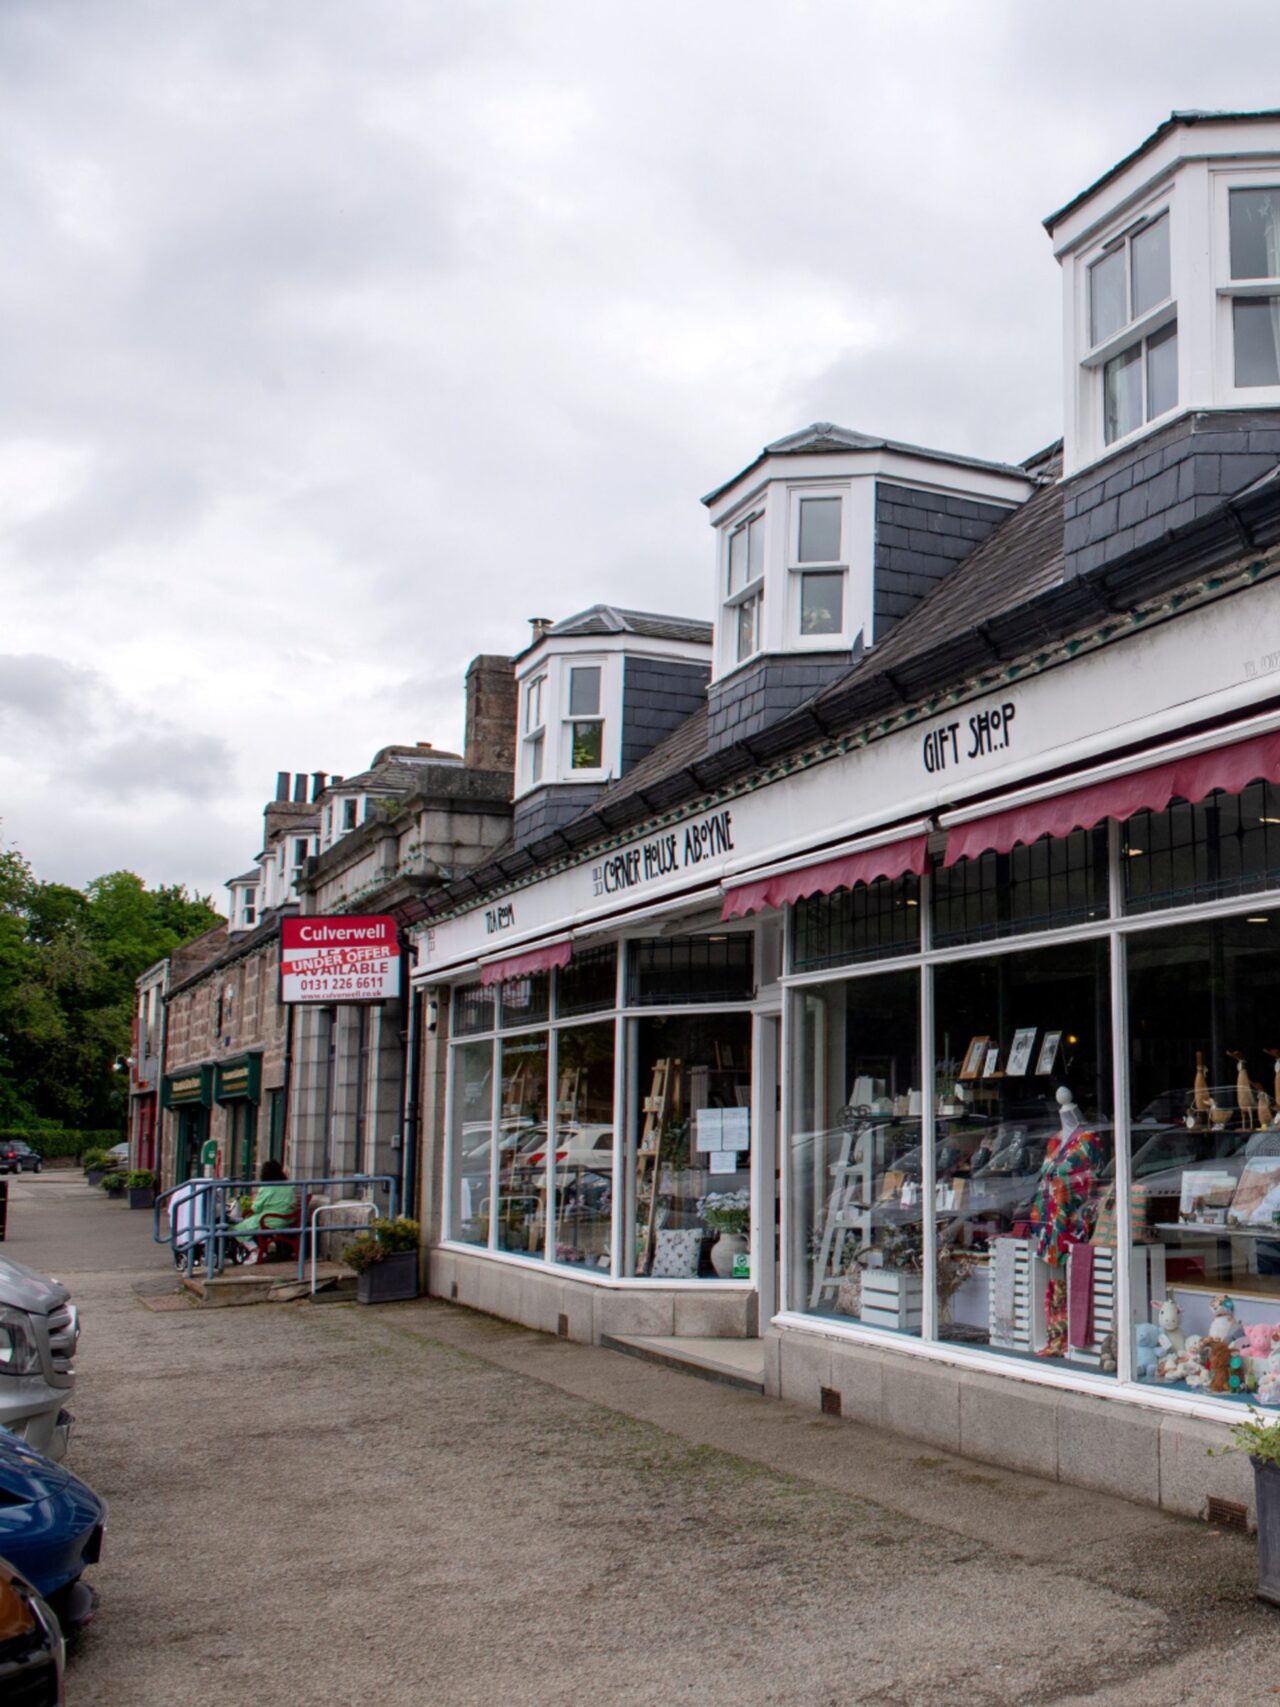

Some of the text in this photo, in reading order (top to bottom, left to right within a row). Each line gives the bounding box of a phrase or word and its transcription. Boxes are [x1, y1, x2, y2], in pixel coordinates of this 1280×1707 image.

[923, 702, 1016, 774] GIFT SHOP
[603, 810, 735, 894] CORNER HOUSE ABOYNE
[299, 923, 386, 941] Culverwell
[291, 954, 343, 972] UNDER
[345, 945, 391, 963] OFFER
[300, 976, 384, 991] 0131 226 6611
